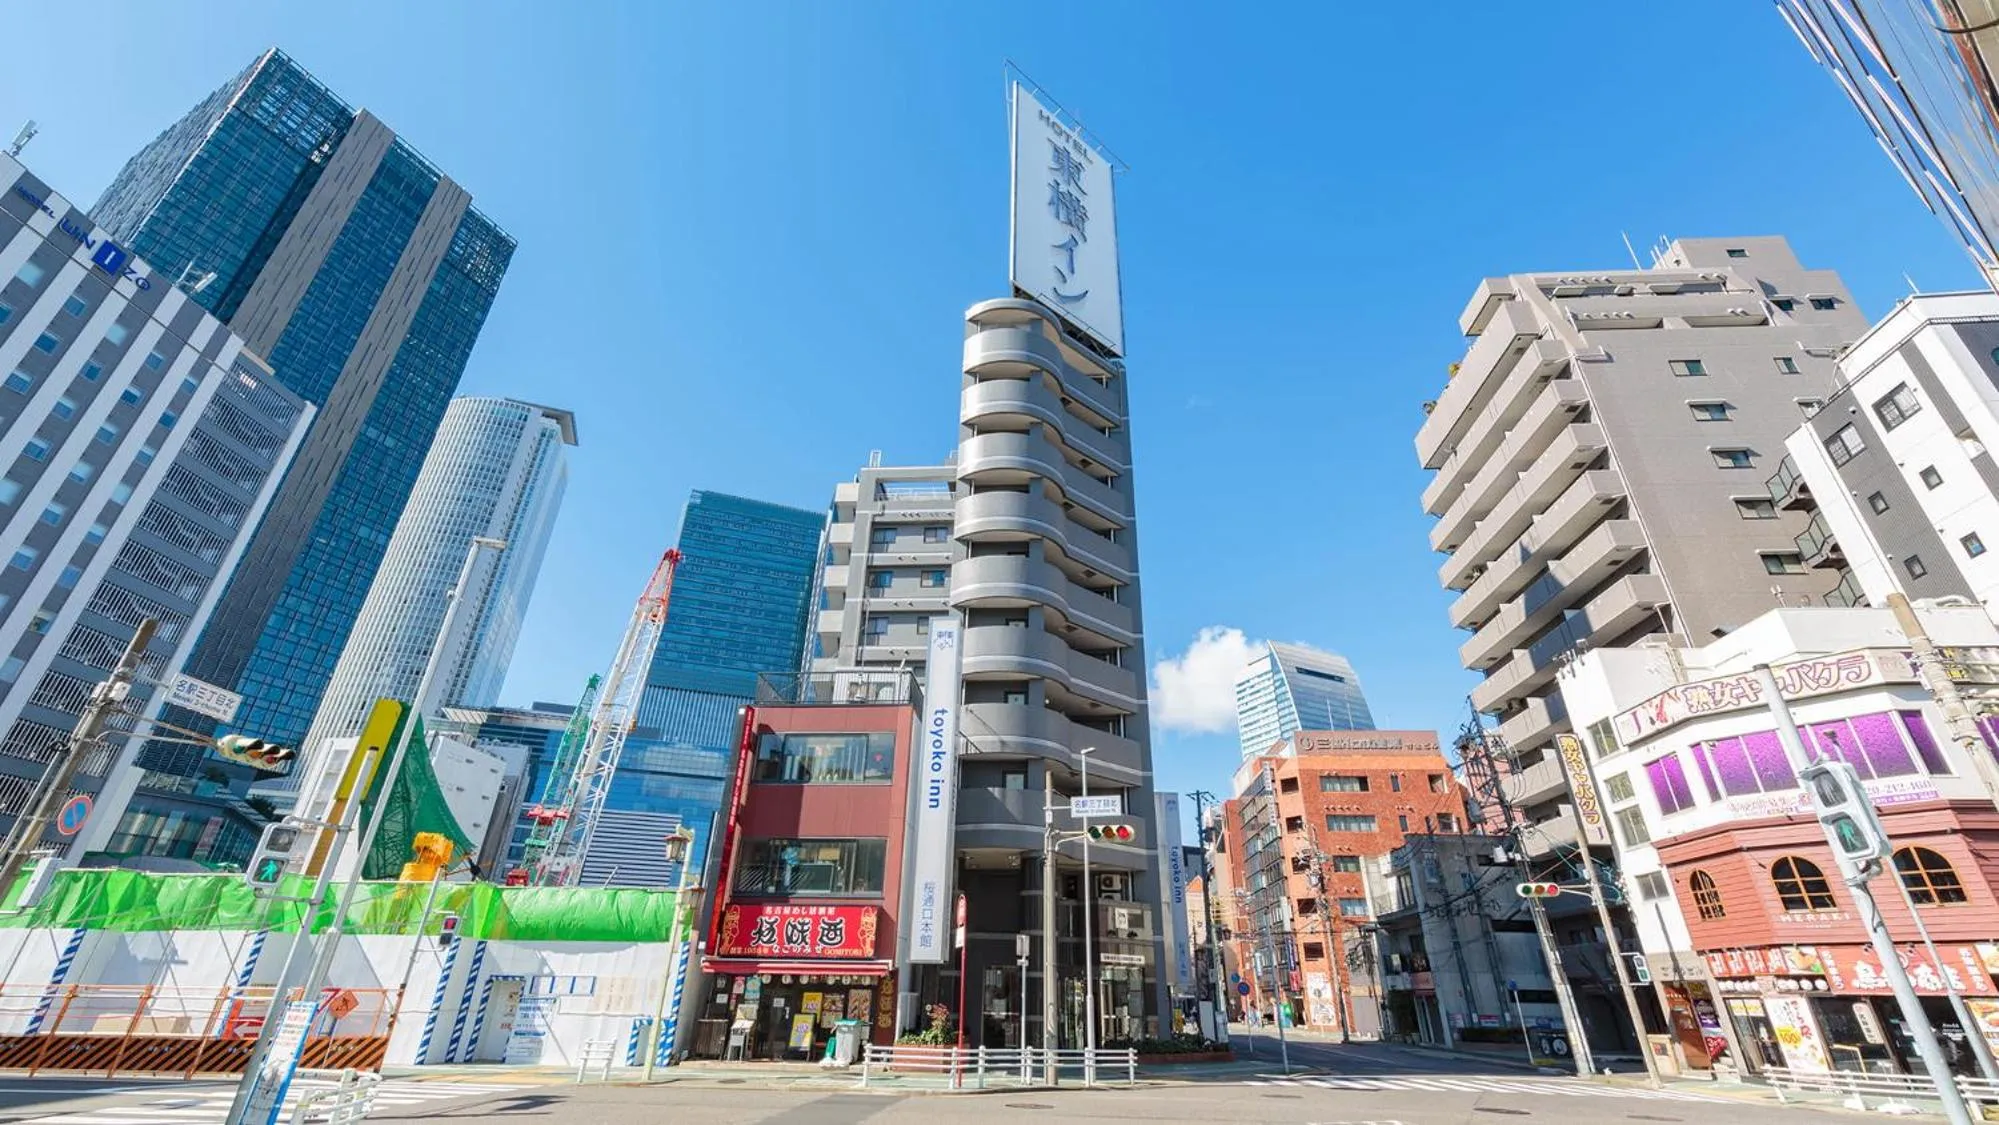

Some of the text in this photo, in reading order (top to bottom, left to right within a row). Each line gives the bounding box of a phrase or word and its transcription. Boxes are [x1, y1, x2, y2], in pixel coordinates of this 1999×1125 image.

[1037, 109, 1093, 163] HOTEL
[1047, 137, 1090, 304] 東横イン
[928, 708, 949, 809] toyoko inn
